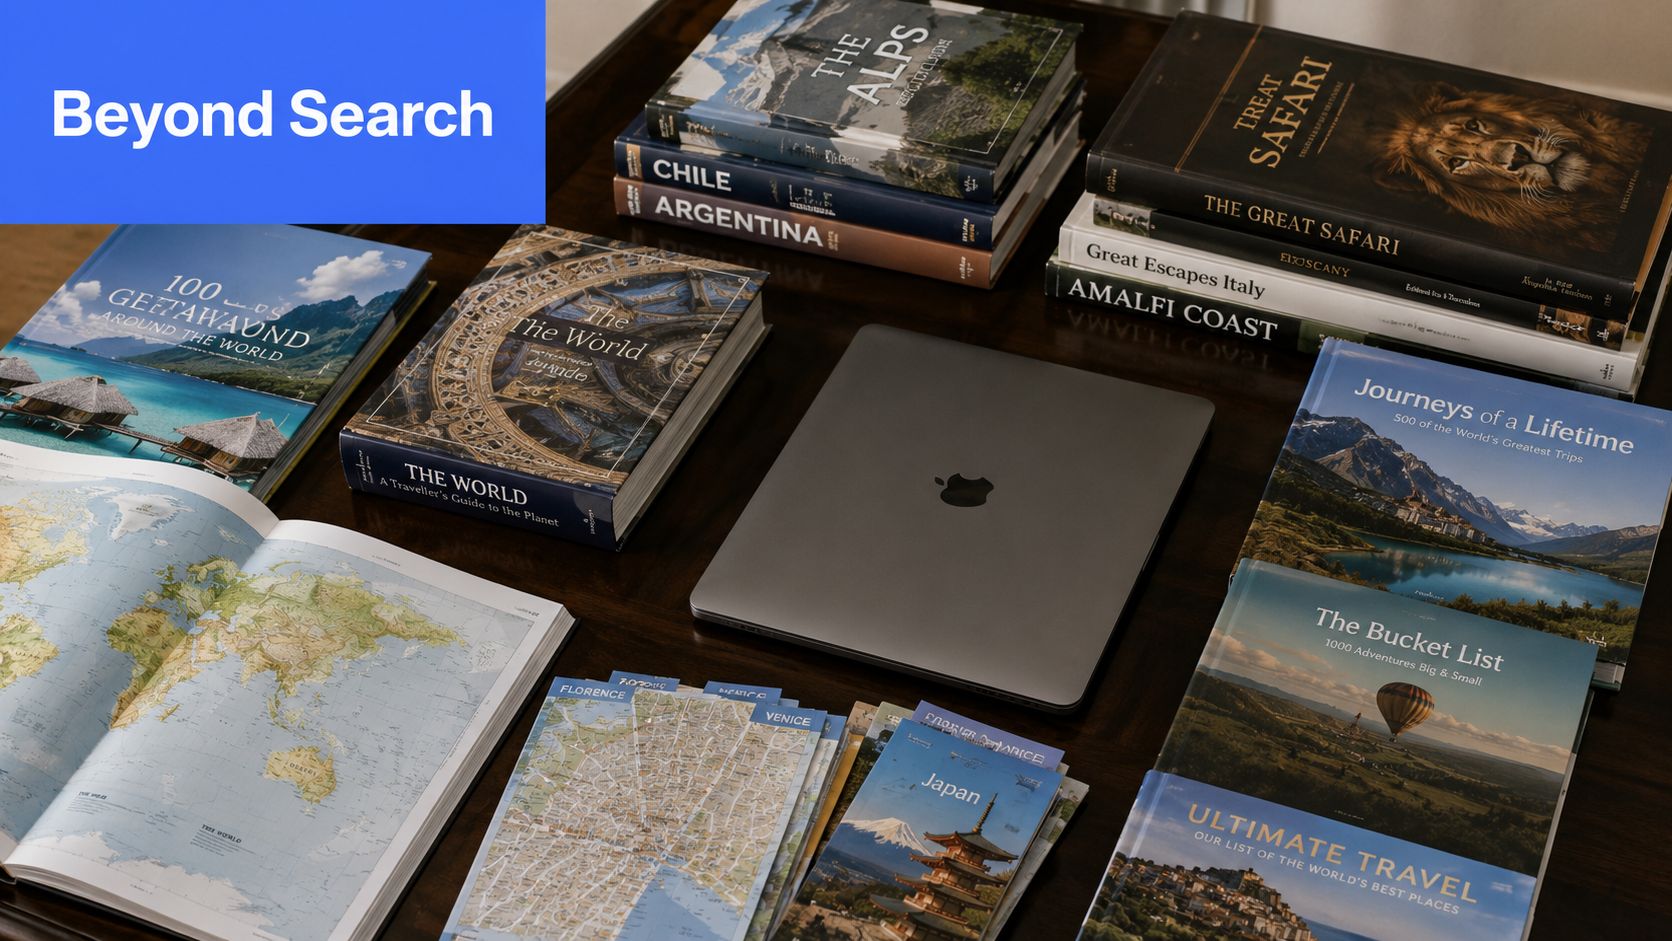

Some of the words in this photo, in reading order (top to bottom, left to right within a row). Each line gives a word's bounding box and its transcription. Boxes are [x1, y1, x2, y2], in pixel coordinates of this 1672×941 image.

[810, 33, 872, 78] THE
[846, 24, 929, 106] ALPS
[1233, 74, 1283, 130] TREAT
[1249, 56, 1333, 168] SAFARI
[653, 159, 732, 192] CHILE
[655, 195, 824, 247] ARGENTINA
[1204, 194, 1242, 218] THE
[1247, 205, 1315, 235] GREAT
[1320, 222, 1400, 257] SAFARI
[164, 275, 222, 300] 100
[1086, 243, 1139, 268] Great
[1144, 257, 1218, 287] Escapes
[1223, 274, 1266, 301] Italy
[585, 304, 629, 329] The
[1068, 277, 1175, 318] AMALFI
[1183, 304, 1278, 341] COAST
[101, 311, 177, 336] AROUND
[183, 329, 216, 346] THE
[220, 337, 283, 361] WORLD
[510, 317, 558, 341] The
[565, 327, 648, 361] World
[1354, 378, 1474, 421] Journeys
[1480, 410, 1505, 426] of
[1507, 416, 1516, 430] a
[1523, 415, 1634, 455] Lifetime
[1393, 413, 1416, 427] 500
[1419, 419, 1433, 430] of
[1434, 422, 1452, 434] the
[1456, 427, 1499, 445] World's
[1502, 438, 1551, 457] Greatest
[1555, 449, 1583, 464] Trips
[380, 477, 389, 486] A
[389, 478, 448, 500] Traveller's
[451, 493, 485, 509] Guide
[488, 503, 499, 512] to
[502, 506, 521, 518] the
[524, 510, 560, 527] Planet
[404, 463, 447, 487] THE
[451, 474, 528, 505] WORLD
[1316, 607, 1360, 635] The
[1366, 621, 1452, 659] Bucket
[1456, 644, 1504, 672] List
[1325, 638, 1352, 652] 1000
[1354, 646, 1416, 670] Adventures
[1419, 663, 1437, 677] Big
[1439, 668, 1449, 678] &
[1451, 671, 1482, 687] Small
[560, 685, 626, 700] FLORENCE
[765, 711, 812, 727] VENICE
[922, 772, 981, 805] Japan
[1187, 803, 1346, 865] ULTIMATE
[1358, 850, 1478, 904] TRAVEL
[1194, 831, 1222, 846] OUR
[1225, 840, 1254, 855] LIST
[1257, 849, 1275, 861] OF
[1279, 855, 1304, 870] THE
[1309, 862, 1368, 888] WORLD'S
[1371, 882, 1406, 899] BEST
[1408, 892, 1460, 915] PLACES
